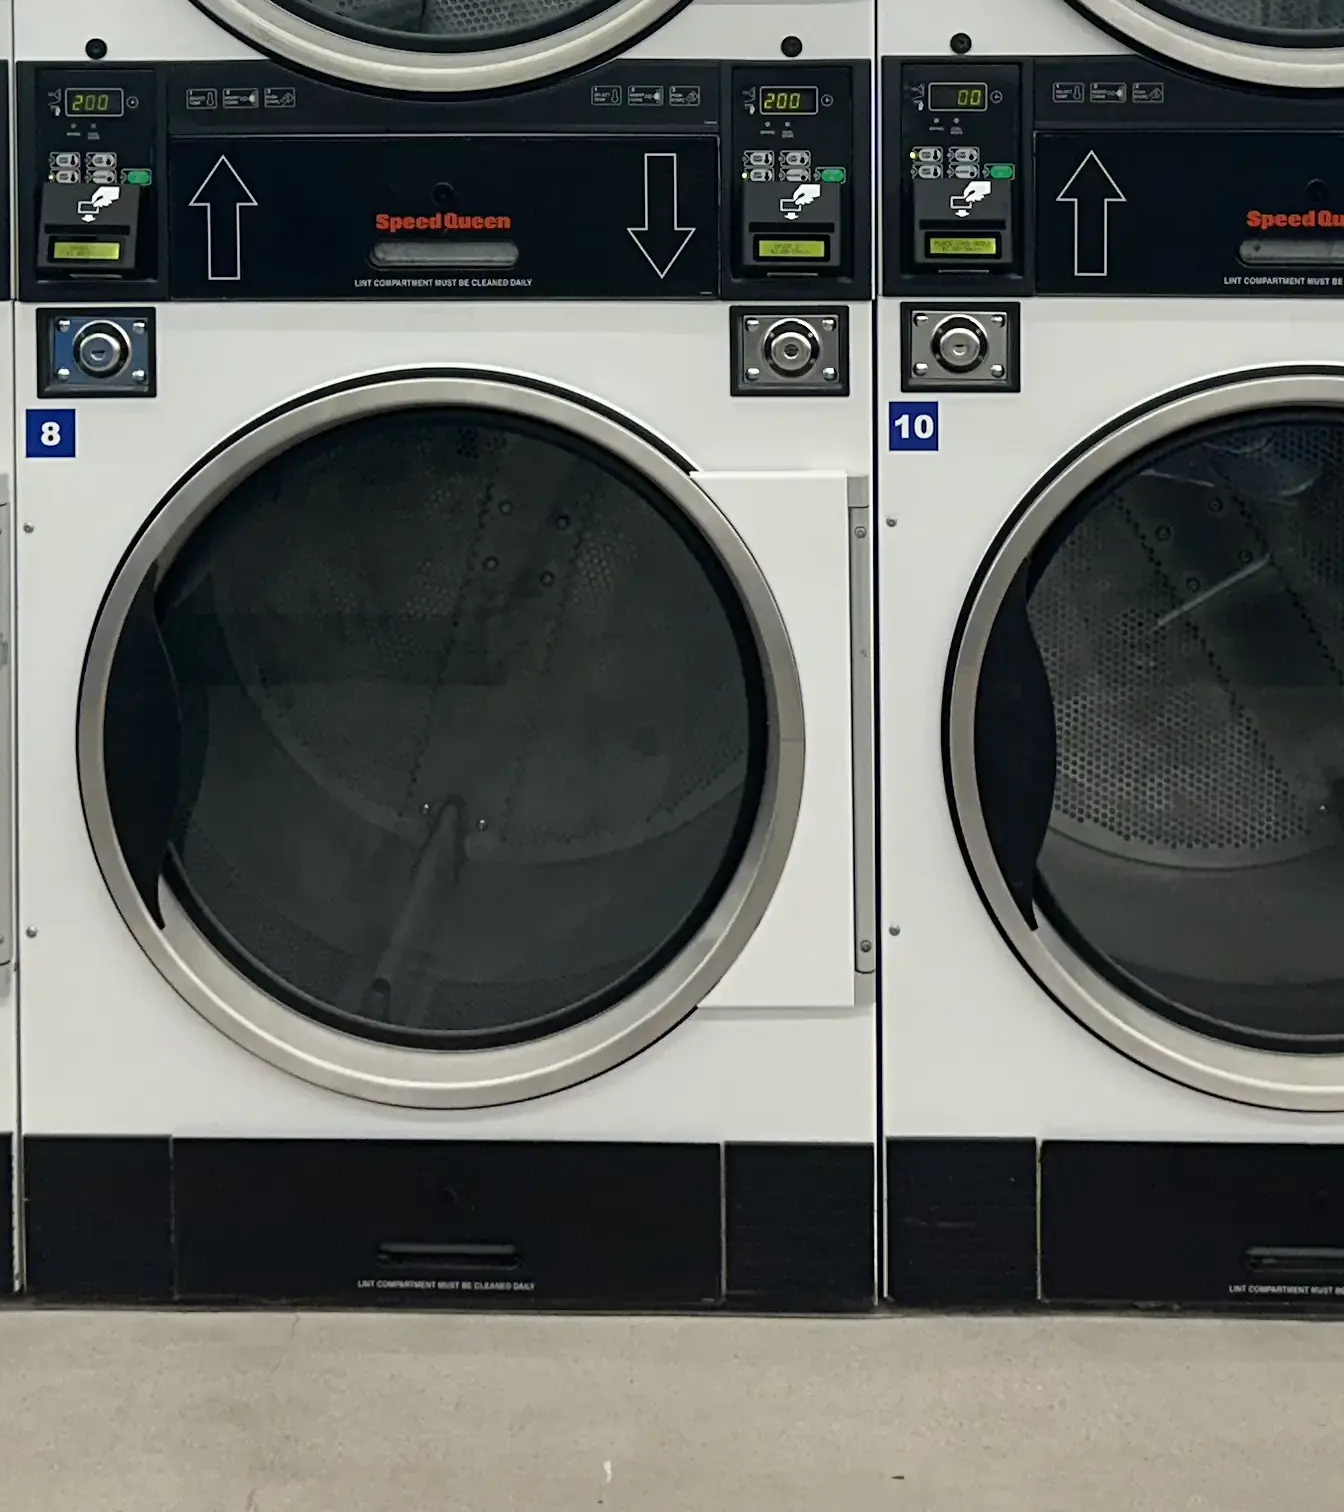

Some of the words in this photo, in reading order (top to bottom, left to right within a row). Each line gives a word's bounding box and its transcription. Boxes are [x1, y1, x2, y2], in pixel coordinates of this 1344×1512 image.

[72, 93, 109, 111] 200
[763, 92, 801, 110] 200
[376, 213, 442, 233] Speed
[443, 213, 512, 230] Queen
[1247, 210, 1316, 230] Speed
[354, 279, 372, 287] LINT
[373, 279, 433, 287] COMPARTMENT
[434, 279, 457, 287] MUST
[458, 279, 469, 287] BE
[470, 279, 508, 287] CLEANED
[509, 279, 533, 287] DAILY
[1223, 277, 1242, 285] LINT
[1243, 277, 1305, 285] COMPARTMENT
[1306, 278, 1330, 286] MUST
[1331, 278, 1343, 286] BE
[40, 421, 61, 446] 8
[894, 414, 934, 439] 10
